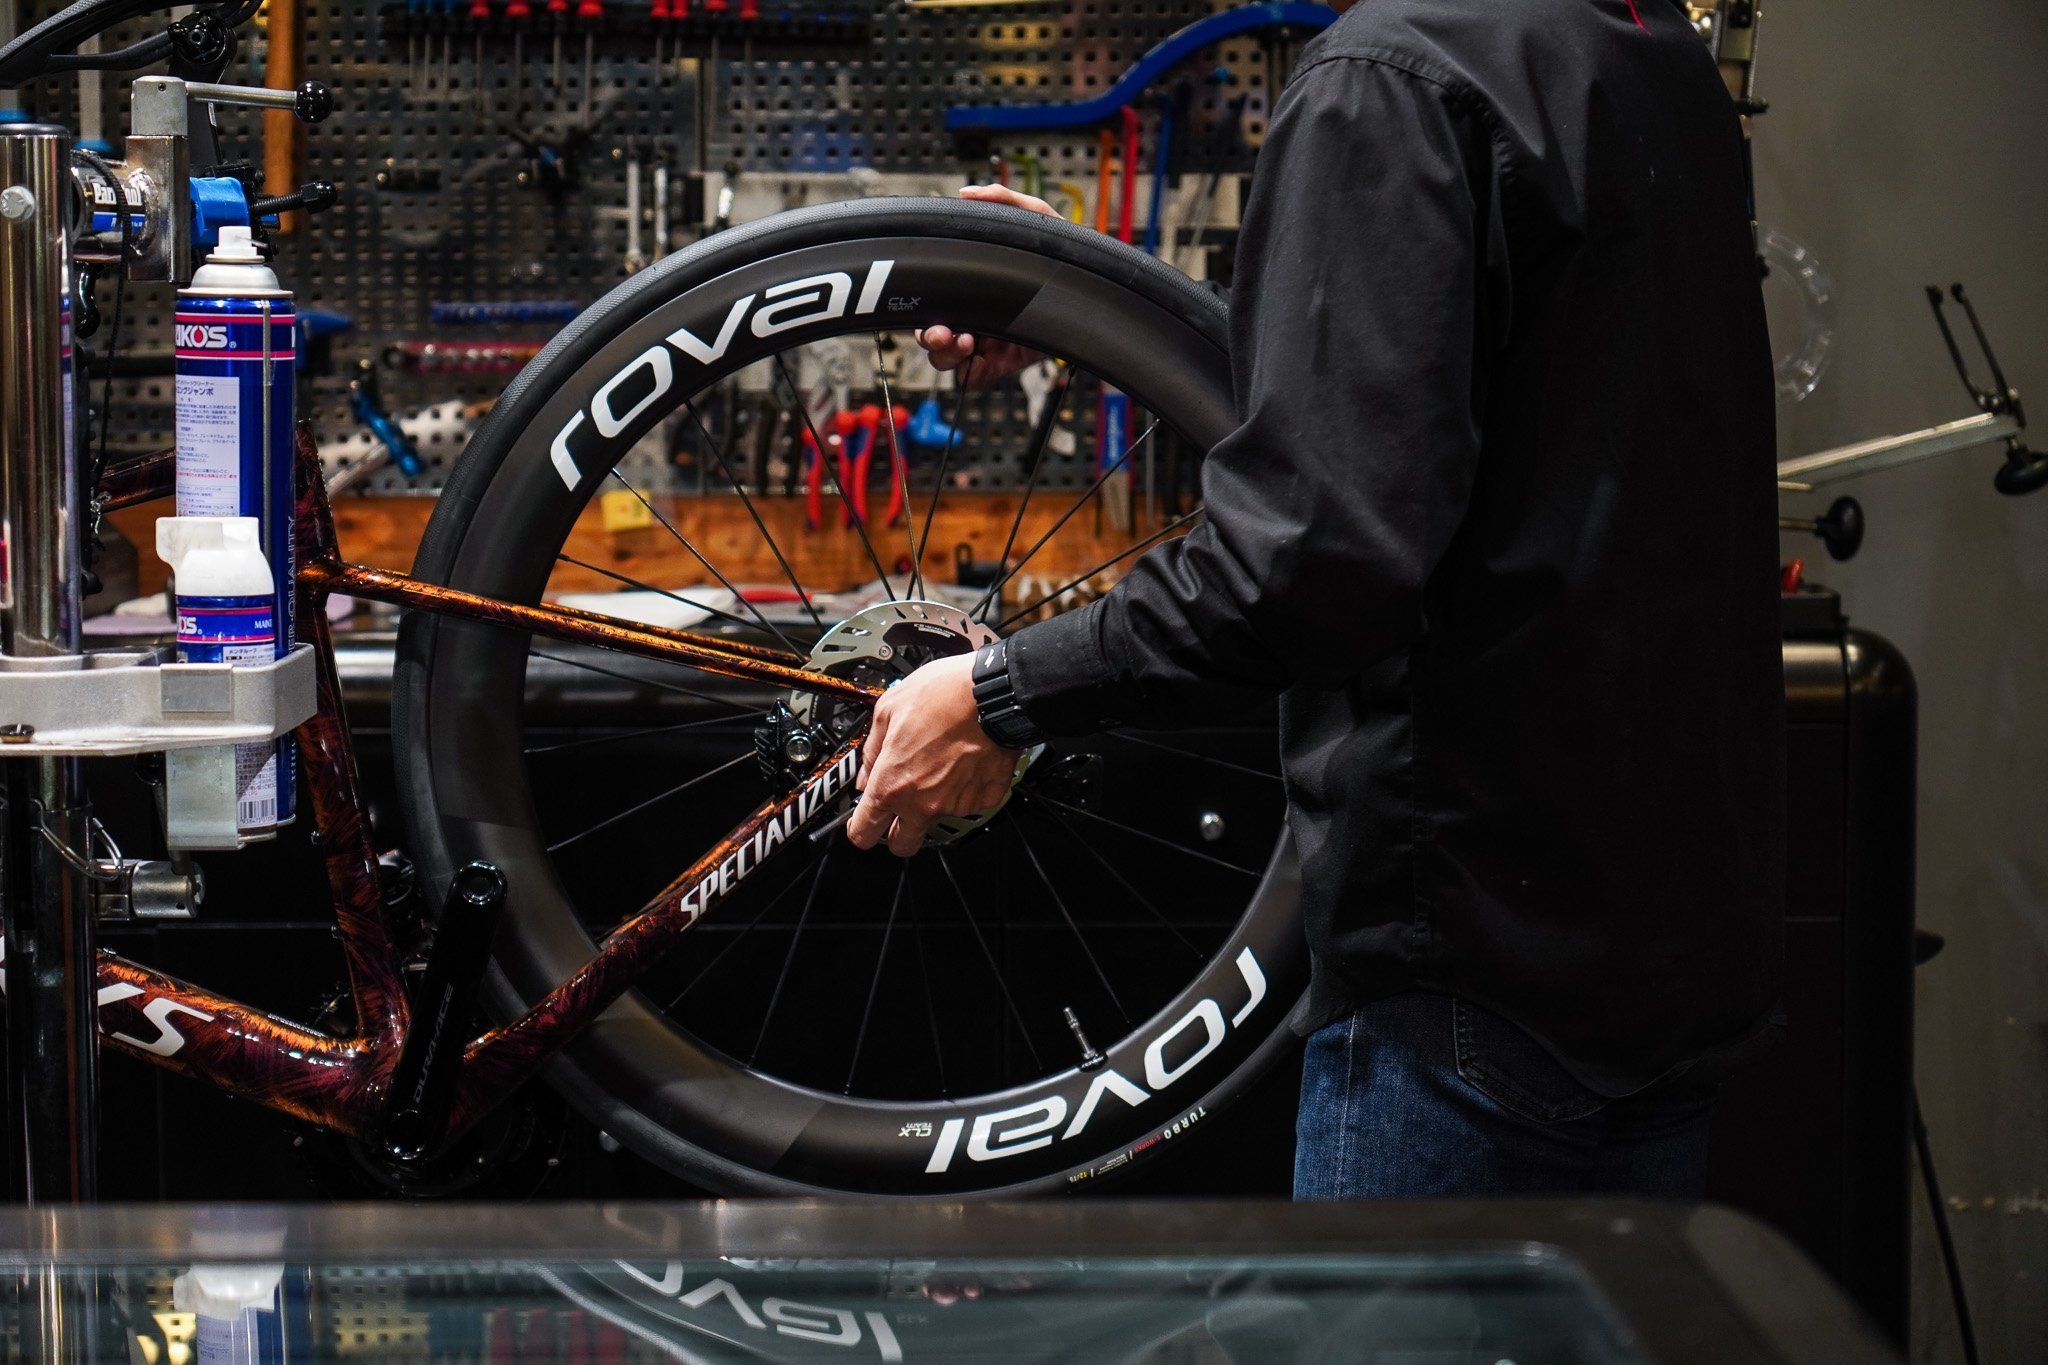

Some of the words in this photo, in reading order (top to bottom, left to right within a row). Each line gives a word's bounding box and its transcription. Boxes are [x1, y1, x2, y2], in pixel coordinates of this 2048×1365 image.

[888, 297, 921, 306] CLX
[550, 260, 895, 492] roval
[680, 748, 857, 933] SPECIALIZED
[413, 982, 454, 1104] DURA-ACE
[925, 946, 1267, 1174] roval
[898, 1127, 932, 1138] CLX
[1163, 1106, 1207, 1140] TURBO
